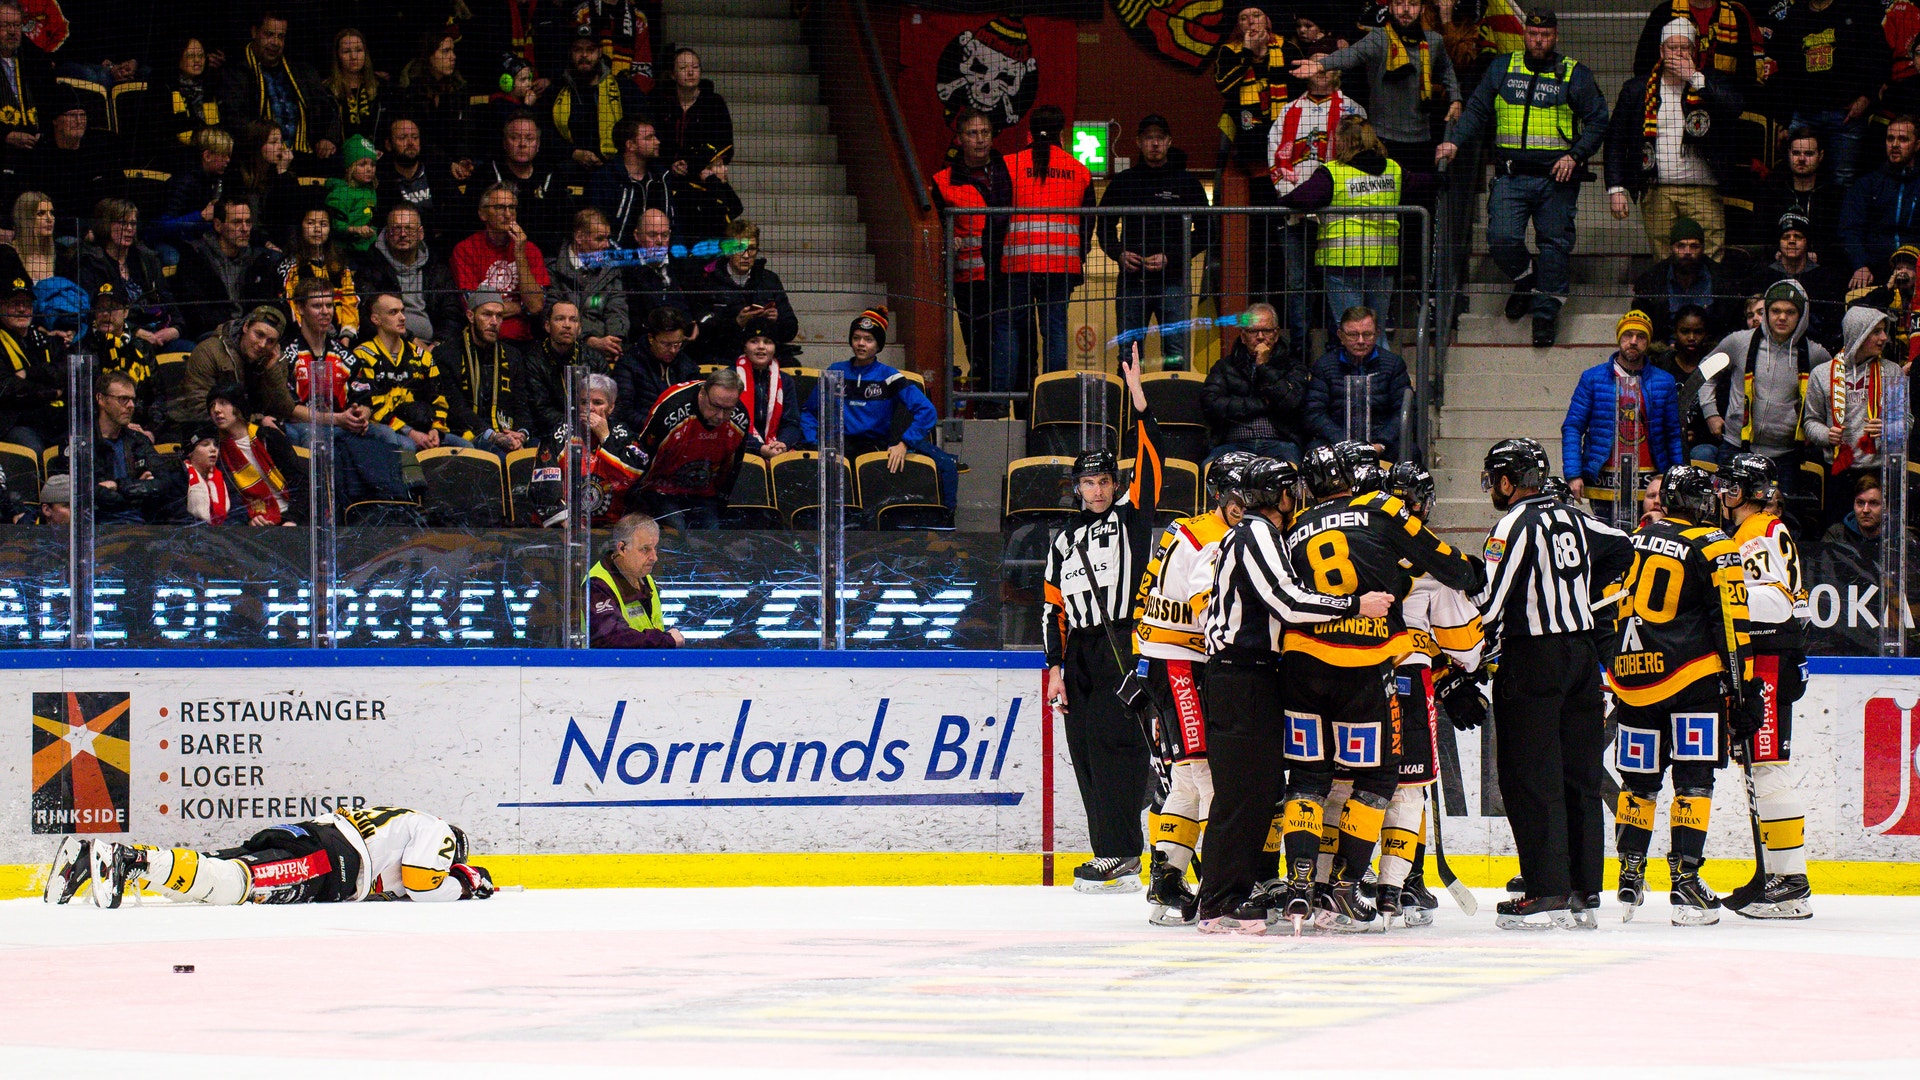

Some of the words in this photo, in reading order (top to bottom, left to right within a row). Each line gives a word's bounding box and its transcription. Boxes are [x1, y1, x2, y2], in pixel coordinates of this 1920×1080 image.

[1093, 525, 1118, 539] SHL
[1288, 512, 1369, 550] BOLIDEN
[1552, 532, 1580, 570] 68
[1629, 534, 1691, 561] OLIDEN
[1065, 562, 1108, 581] GROLS
[1306, 530, 1358, 595] 8
[1744, 551, 1771, 581] 37
[152, 580, 243, 639] OF
[267, 580, 541, 639] HOCKEY
[180, 700, 387, 723] RESTAURANGER
[180, 734, 263, 755] BARER
[552, 699, 910, 786] Norrlands
[924, 698, 1022, 781] Bil
[180, 766, 264, 788] LOGER
[1398, 763, 1425, 775] LKAB
[36, 809, 125, 824] RINKSIDE
[180, 796, 367, 820] KONFERENSER
[1384, 837, 1409, 852] NEX
